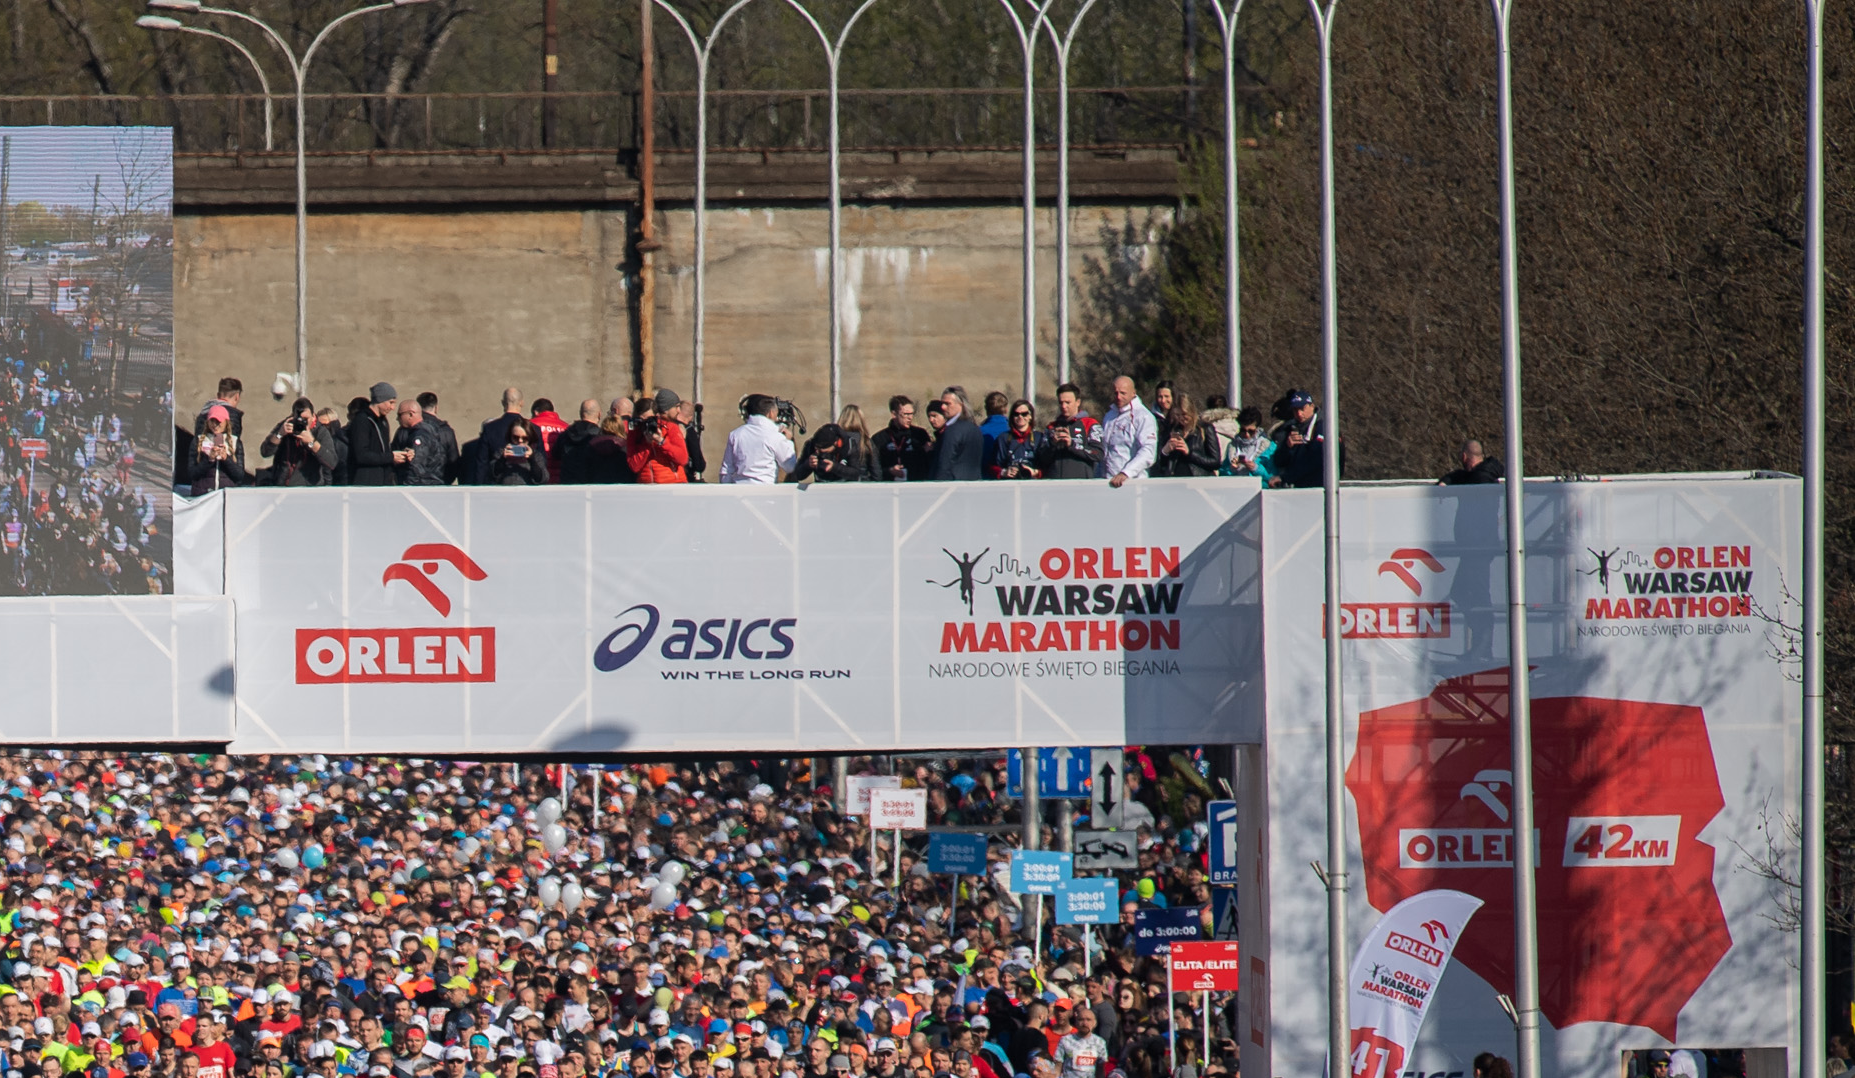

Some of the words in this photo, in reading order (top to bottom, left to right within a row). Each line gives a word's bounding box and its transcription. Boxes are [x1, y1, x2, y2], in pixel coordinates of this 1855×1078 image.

[1040, 546, 1181, 580] ORLEN
[1654, 546, 1751, 568] ORLEN
[1624, 570, 1753, 594] WARSAW
[995, 583, 1185, 616] WARSAW
[1585, 596, 1751, 620] MARATHON
[1339, 607, 1443, 634] ORLEN
[1577, 625, 1648, 637] NARODOWE
[1651, 622, 1693, 638] ŚWIĘTO
[1697, 623, 1751, 635] BIEGANIA
[661, 617, 797, 660] asics
[940, 619, 1181, 653] MARATHON
[306, 635, 483, 676] ORLEN
[661, 670, 698, 679] WIN
[704, 670, 743, 679] THE
[750, 670, 804, 679] LONG
[809, 669, 851, 679] RUN
[929, 662, 1031, 679] NARODOWE
[1035, 658, 1097, 680] ŚWIĘTO
[1103, 660, 1182, 677] BIEGANIA
[1407, 834, 1514, 864] ORLE
[1156, 926, 1196, 936] 3:00:00
[1388, 935, 1441, 965] ORLEN
[1173, 960, 1237, 969] ELITA/ELITE
[1380, 975, 1428, 1000] WARSAW
[1394, 970, 1431, 991] ORLEN
[1362, 981, 1424, 1009] MARATHON
